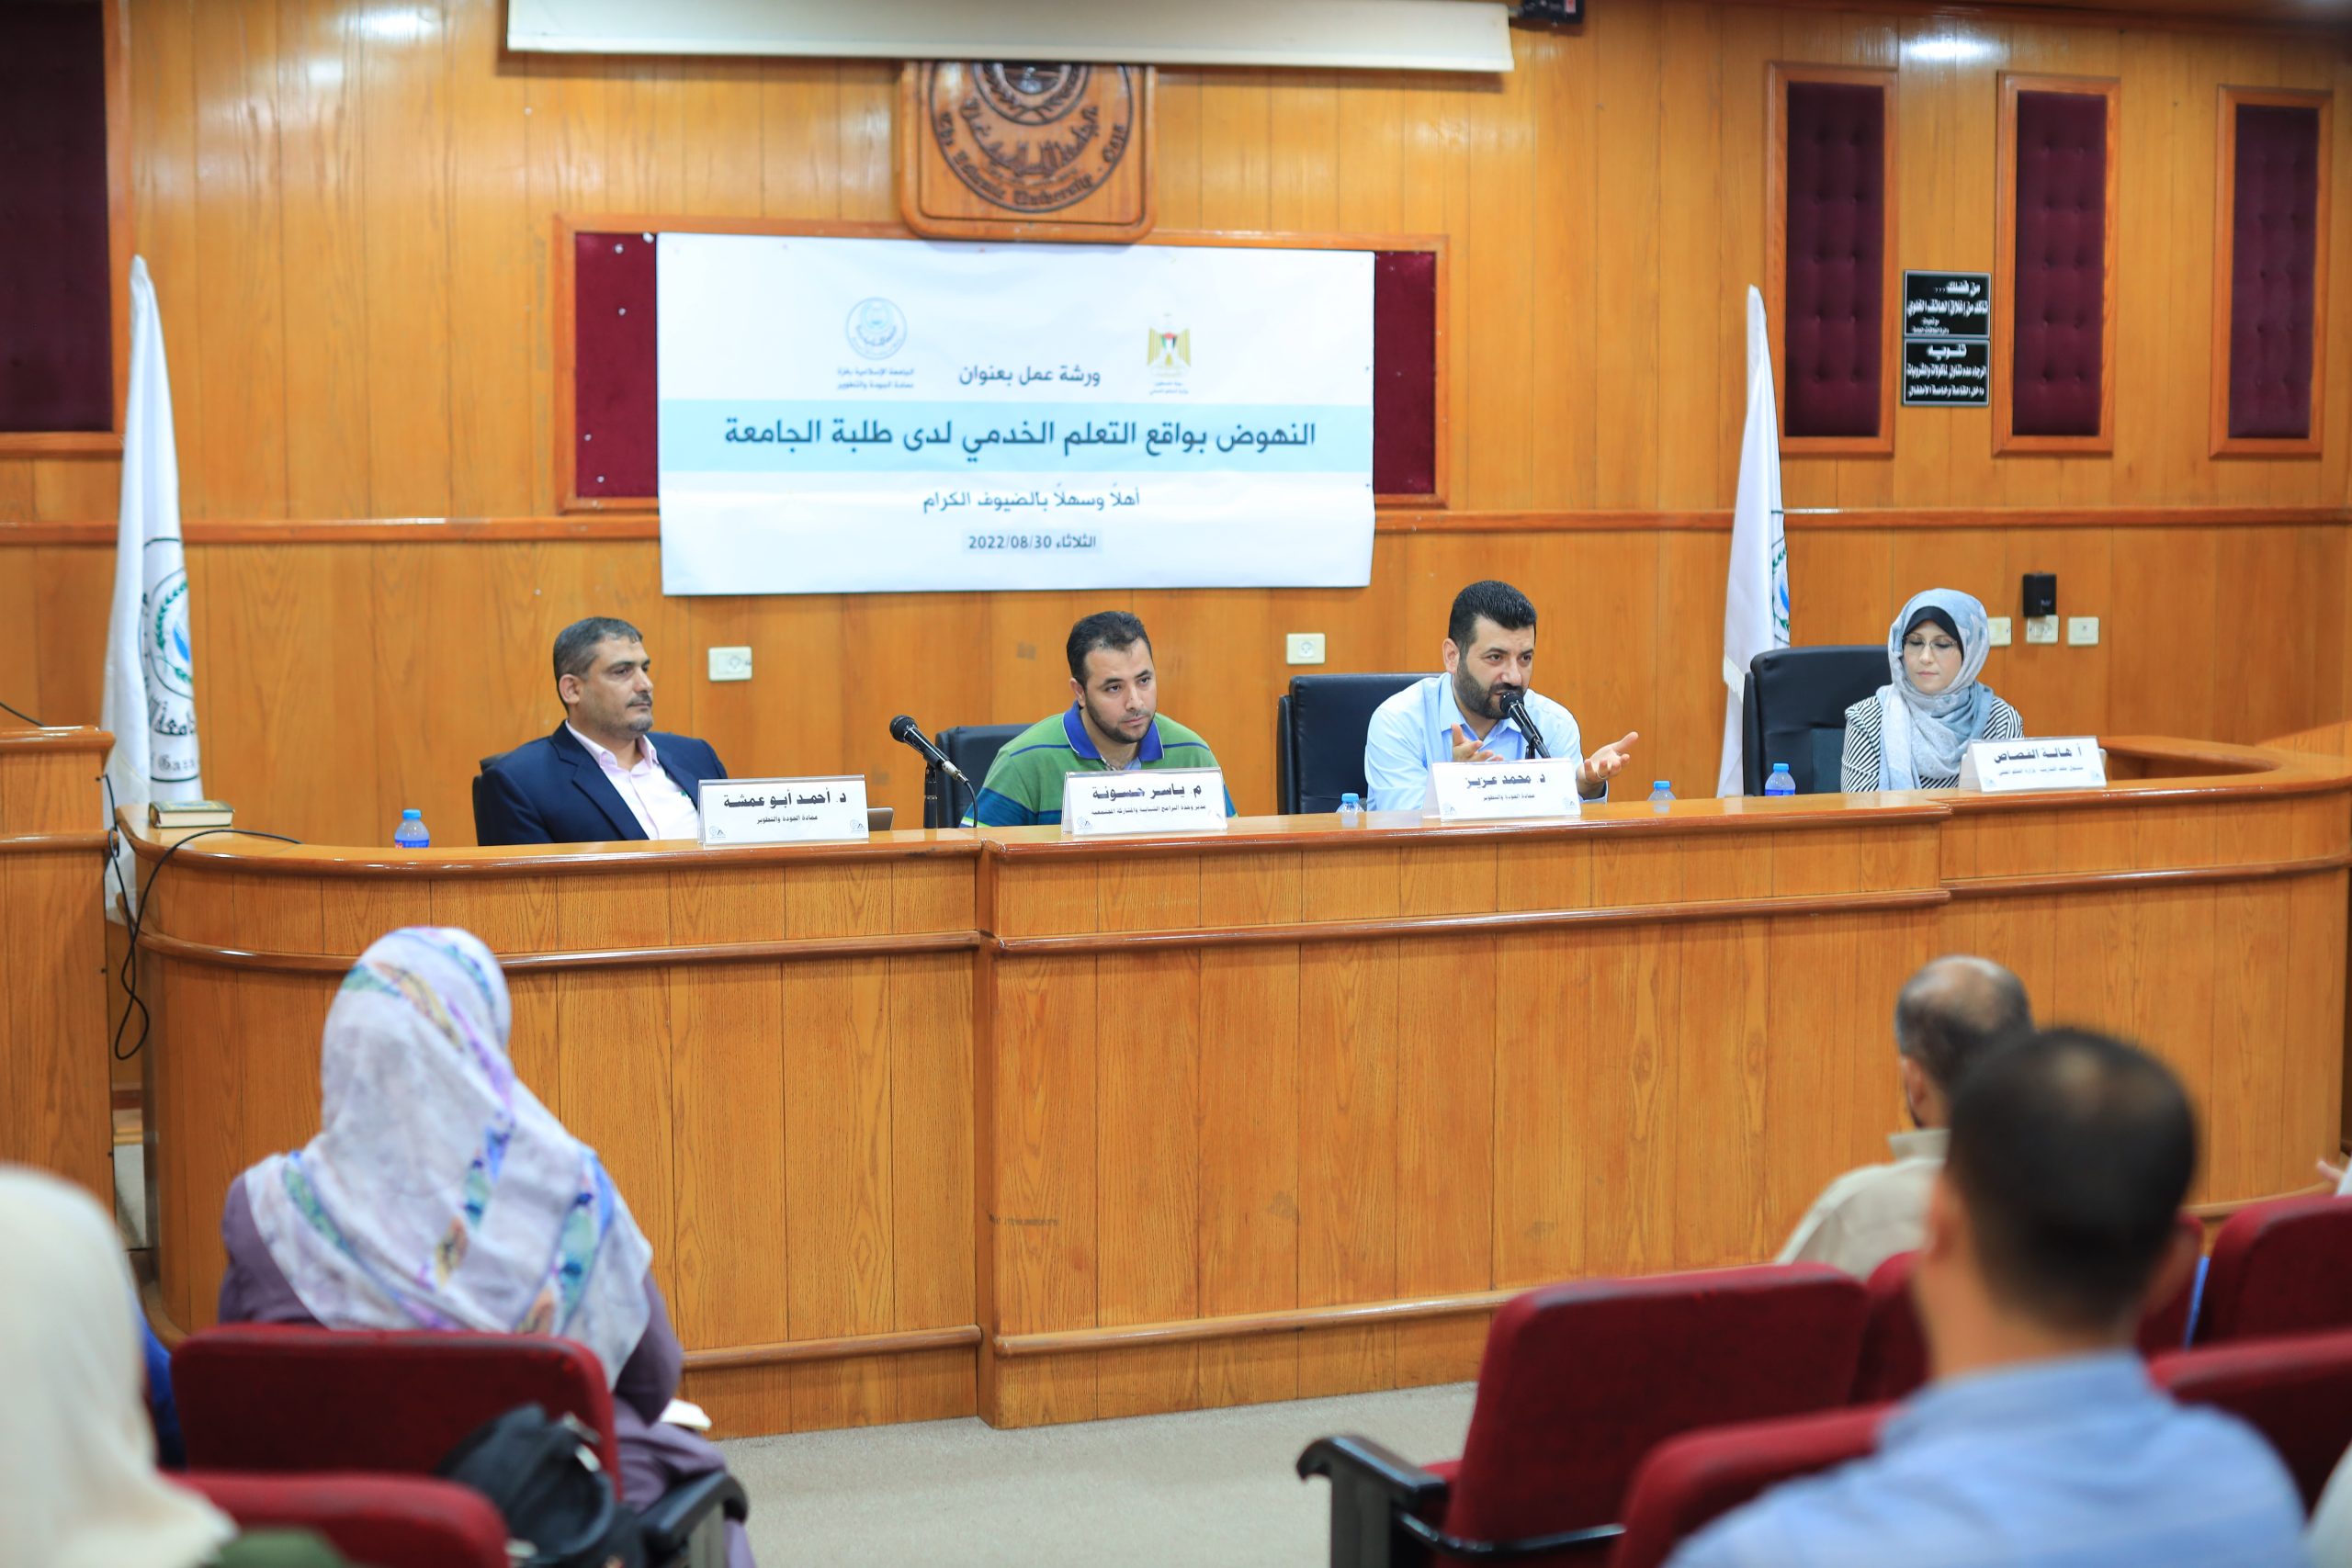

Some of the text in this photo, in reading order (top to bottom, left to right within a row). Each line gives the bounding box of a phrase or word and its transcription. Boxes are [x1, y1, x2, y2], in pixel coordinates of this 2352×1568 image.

[959, 364, 1101, 387] ورشة عمل بعنوان
[725, 417, 1316, 463] النهوض بواقع التعلم الخدمي لدى طلبة الجامعة
[923, 491, 971, 514] الكرام
[978, 491, 1048, 513] بالضيوف
[968, 534, 1097, 550] الثلاثاء 2022/08/30
[1465, 775, 1498, 790] عزيز
[1502, 773, 1532, 784] محمد
[724, 787, 847, 809] د. أحمد أبو عمشة
[1092, 785, 1146, 802] حسونة
[1150, 783, 1185, 799] ياسر
[756, 816, 781, 825] والتطوير
[783, 815, 801, 823] الجودة
